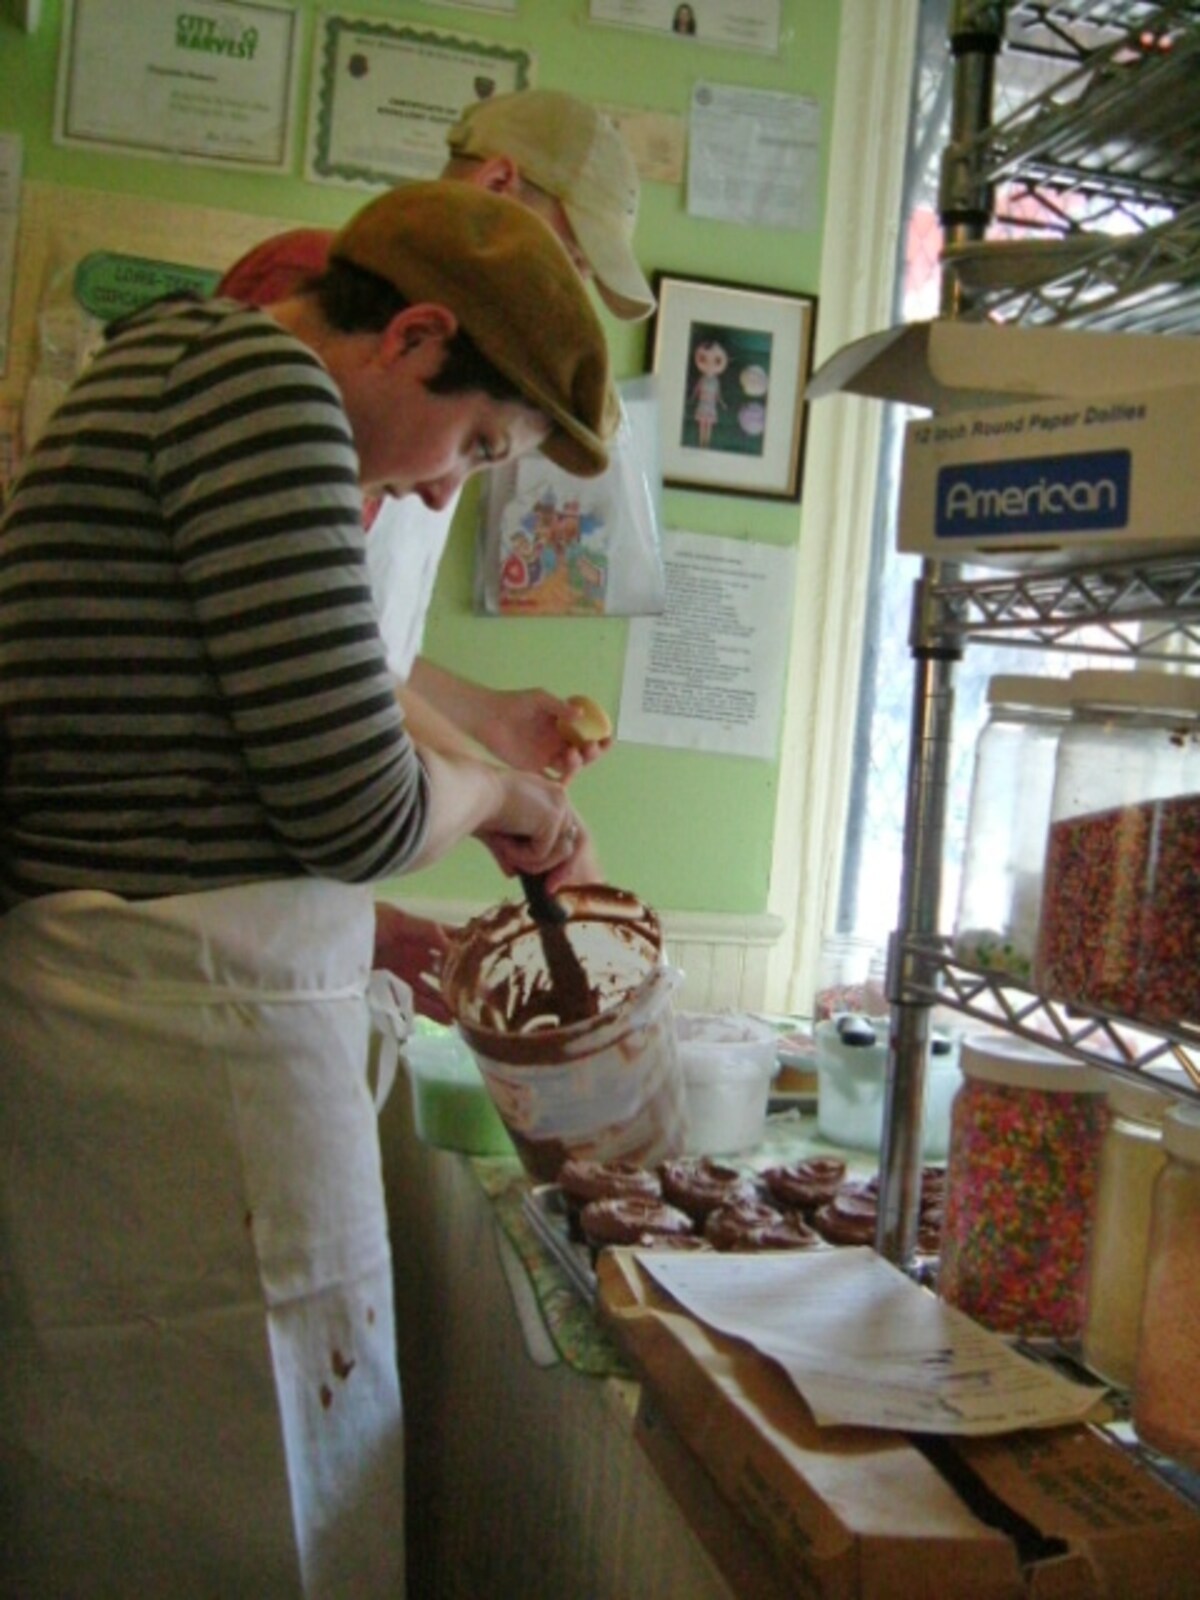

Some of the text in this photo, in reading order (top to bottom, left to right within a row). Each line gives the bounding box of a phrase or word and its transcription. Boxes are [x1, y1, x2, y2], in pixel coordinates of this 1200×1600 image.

[176, 14, 217, 34] CITY
[176, 30, 257, 60] HARVEST
[971, 417, 1024, 436] Round
[1029, 411, 1080, 432] Paper
[946, 478, 1117, 519] American
